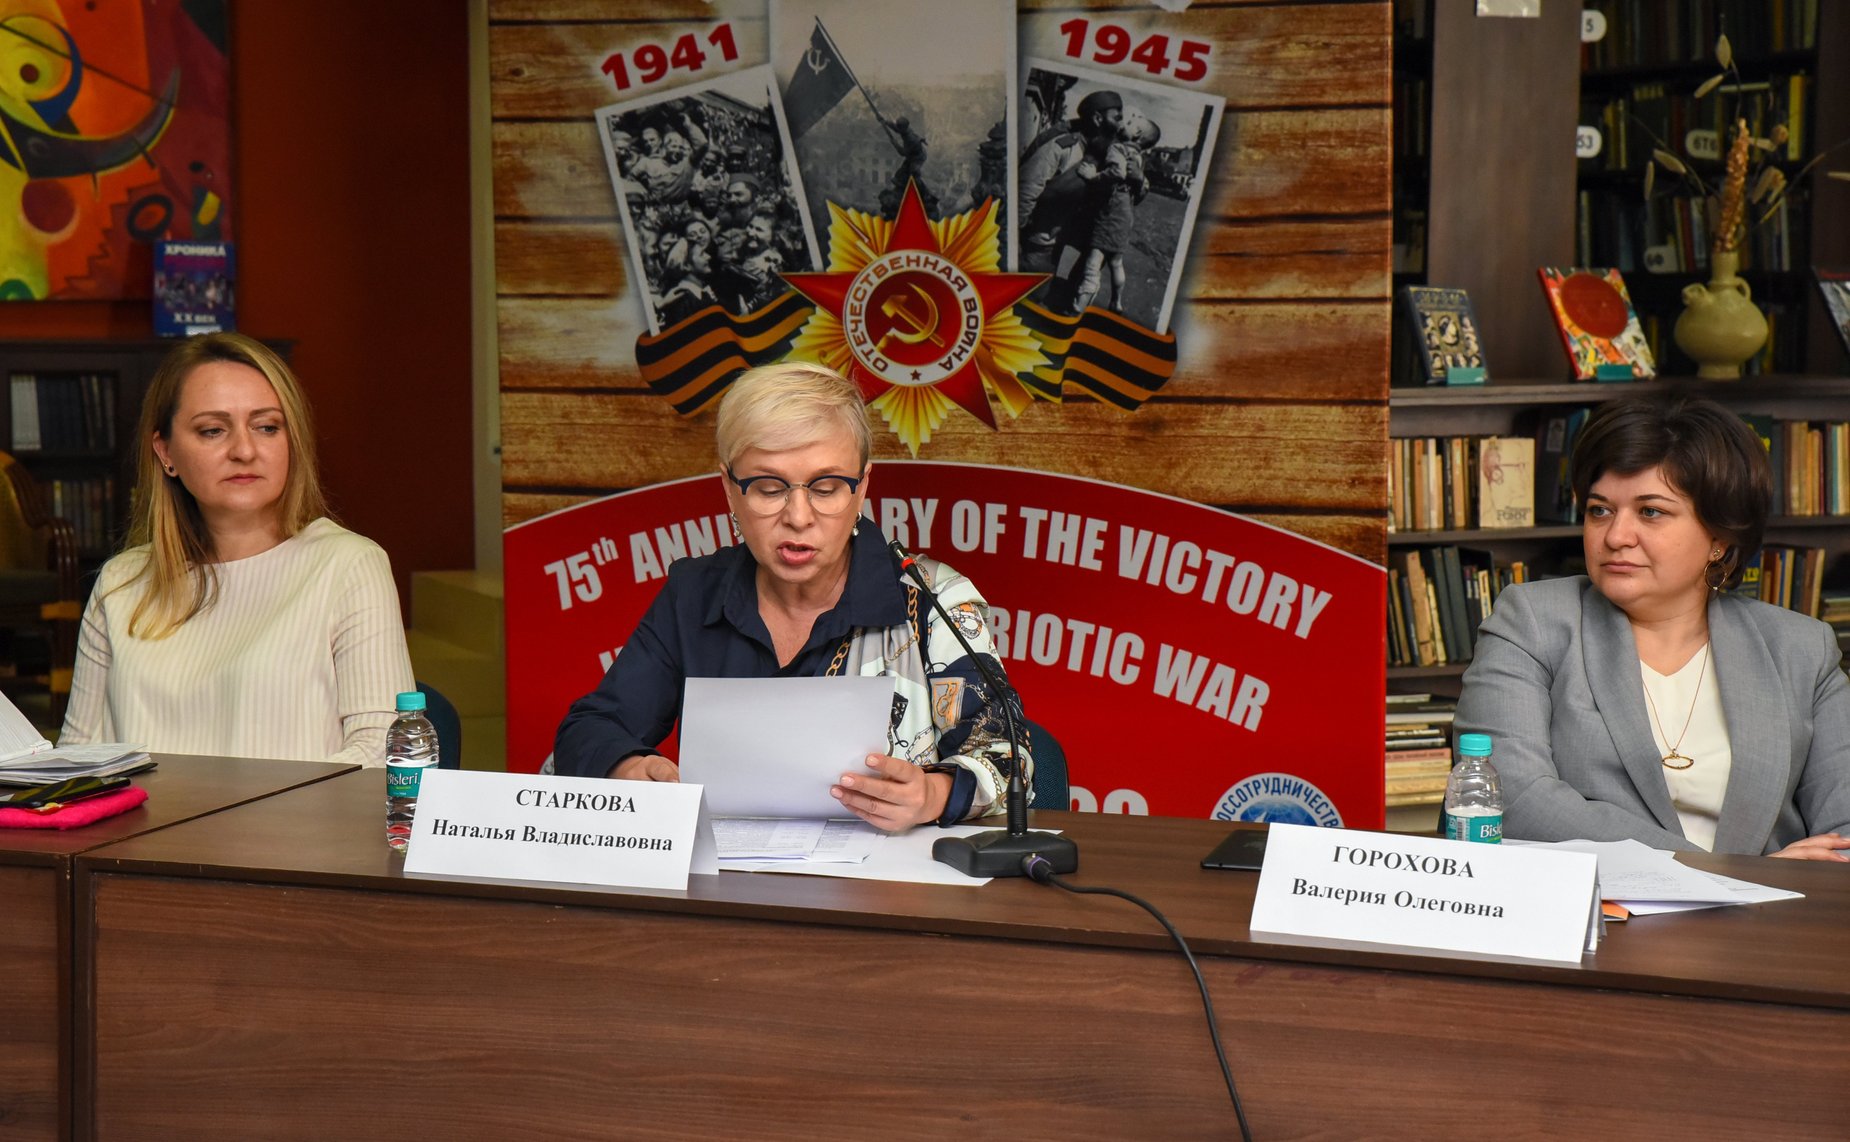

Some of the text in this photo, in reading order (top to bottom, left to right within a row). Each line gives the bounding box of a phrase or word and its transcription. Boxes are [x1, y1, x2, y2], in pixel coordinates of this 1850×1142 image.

[601, 22, 738, 91] 1941
[1060, 18, 1211, 82] 1945
[850, 255, 968, 373] ОТЕЧЕСТВЕННАЯ
[544, 537, 619, 611] 75th
[951, 500, 1007, 554] OF
[1020, 506, 1109, 571] THE
[1118, 525, 1333, 640] VICTORY
[989, 606, 1270, 732] RIOTIC WAR
[387, 772, 418, 785] Bisleri
[516, 789, 636, 813] СТАРКОВА
[1217, 777, 1340, 828] ОССОТРУДНИЧЕСТВ
[432, 818, 673, 851] Наталья Владиславовна
[1332, 845, 1474, 878] ГОРОХОВА
[1291, 877, 1504, 918] Валерия Олеговна
